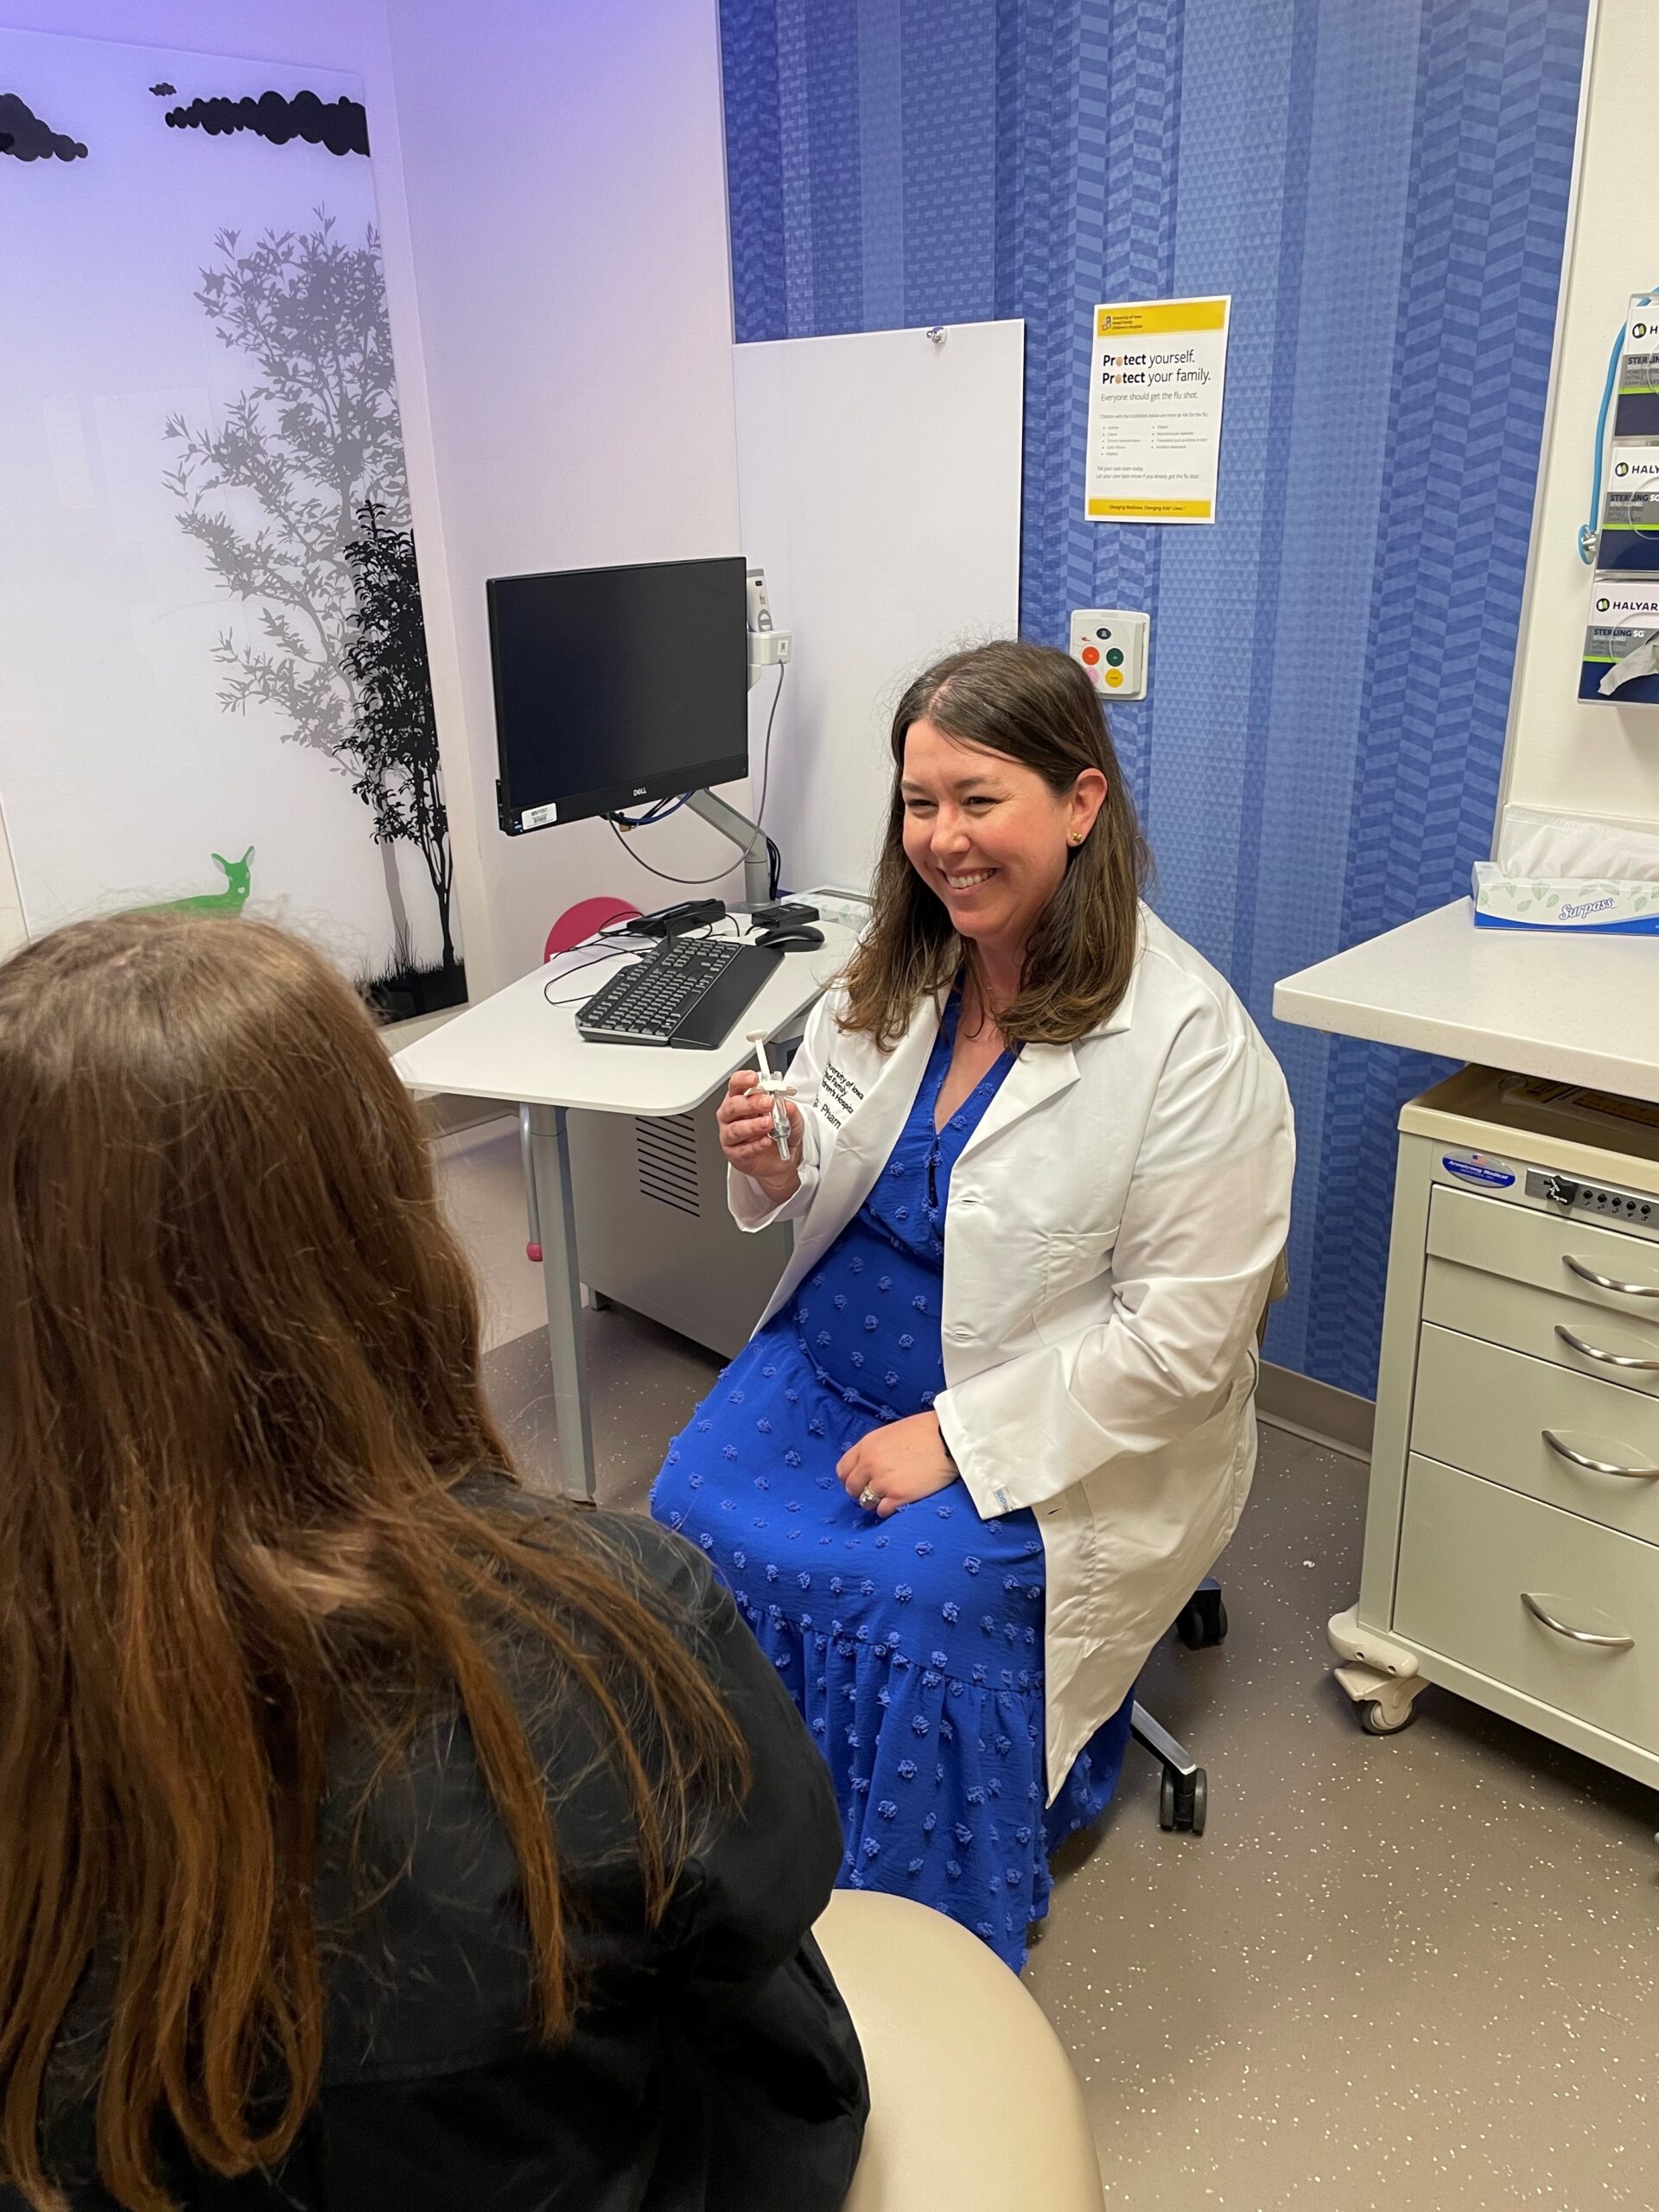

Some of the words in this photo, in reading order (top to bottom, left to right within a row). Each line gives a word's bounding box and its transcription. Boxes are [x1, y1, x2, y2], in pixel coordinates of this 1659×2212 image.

[1103, 353, 1147, 366] Protect
[1147, 349, 1195, 369] yourself.
[1102, 372, 1146, 385] Protect
[1147, 372, 1173, 387] your
[1176, 367, 1211, 385] family.
[1101, 393, 1128, 404] Everyone
[1128, 392, 1150, 401] should
[1150, 392, 1160, 402] get
[1161, 391, 1173, 400] the
[1173, 391, 1183, 399] flu
[1183, 391, 1198, 400] shot.
[632, 787, 647, 797] DELL
[1559, 898, 1614, 921] Surpass
[835, 1092, 854, 1115] Hospita
